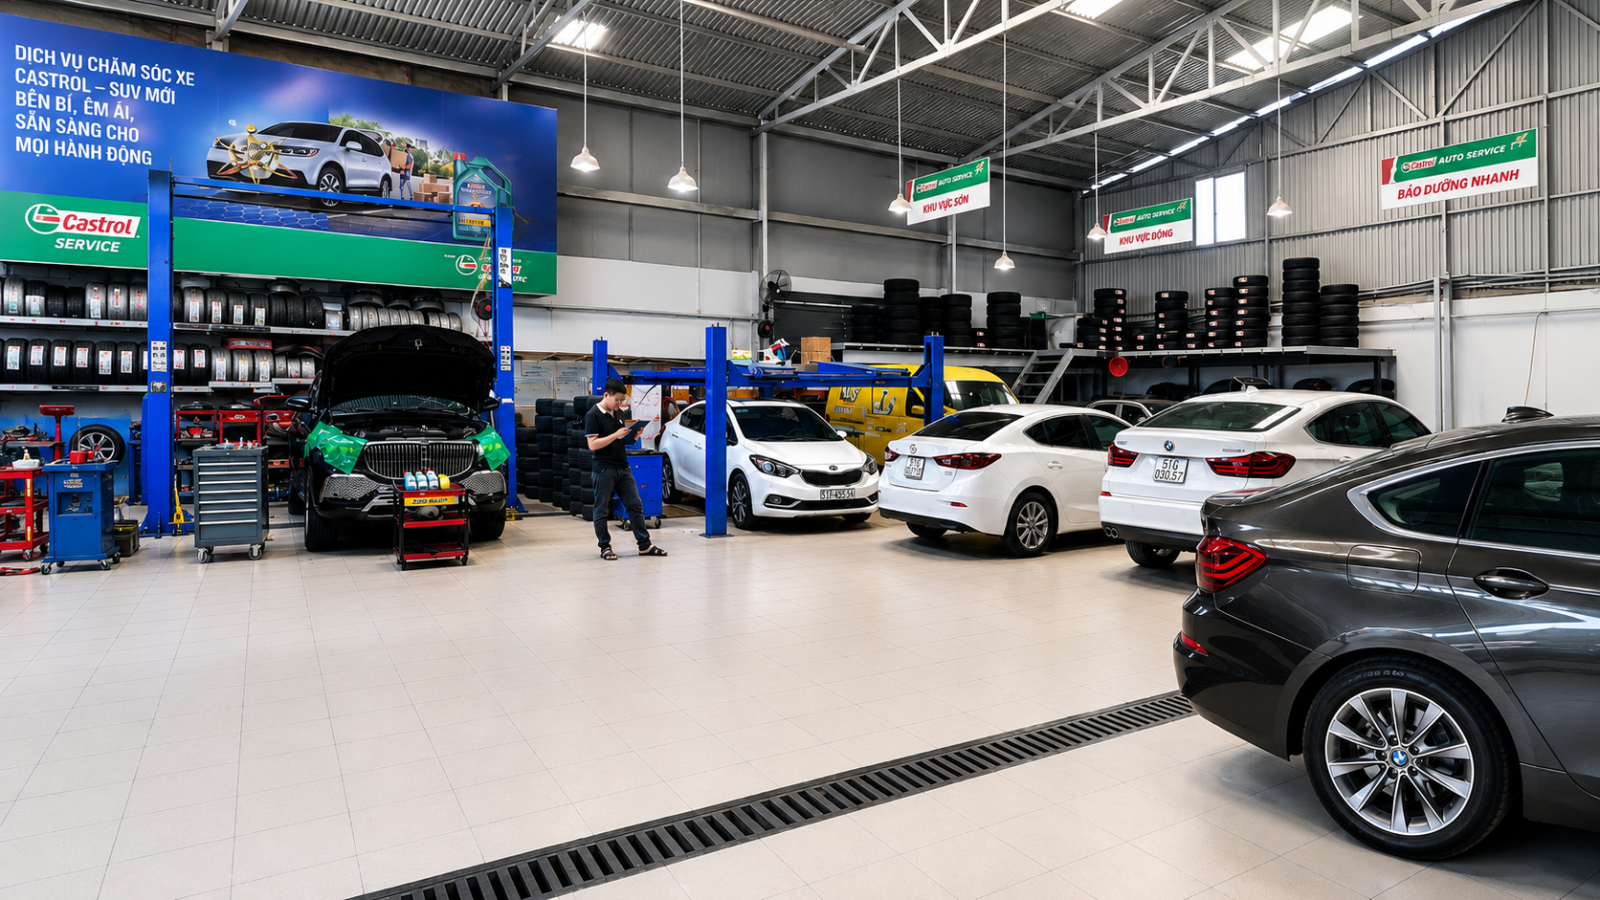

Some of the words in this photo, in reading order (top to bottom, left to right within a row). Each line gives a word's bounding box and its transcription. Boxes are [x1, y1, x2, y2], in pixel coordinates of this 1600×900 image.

[15, 44, 56, 65] DỊCH
[60, 52, 83, 72] VỤ
[87, 56, 136, 78] CHĂM
[141, 64, 172, 83] SÓC
[175, 69, 195, 87] XE
[15, 67, 91, 93] CASTROL
[109, 81, 142, 100] SUV
[145, 86, 176, 105] MỚI
[83, 97, 109, 118] ÊM
[55, 117, 102, 139] SÀNG
[106, 124, 140, 143] CHO
[15, 136, 49, 158] MỌI
[54, 138, 102, 160] HÀNH
[105, 145, 153, 166] ĐỘNG
[1410, 158, 1436, 170] Castrol
[1438, 153, 1464, 165] AUTO
[1466, 144, 1507, 160] SERVICE
[938, 177, 952, 187] AUTO
[1397, 183, 1422, 200] BẢO
[1423, 177, 1468, 196] DƯỠNG
[1471, 168, 1520, 188] NHANH
[923, 202, 938, 214] KHU
[938, 198, 953, 212] VỰC
[62, 213, 133, 235] Castrol
[1136, 213, 1151, 221] AUTO
[54, 237, 121, 253] SERVICE
[1119, 235, 1135, 246] KHU
[1135, 231, 1151, 244] VỰC
[1154, 469, 1184, 481] 030.57
